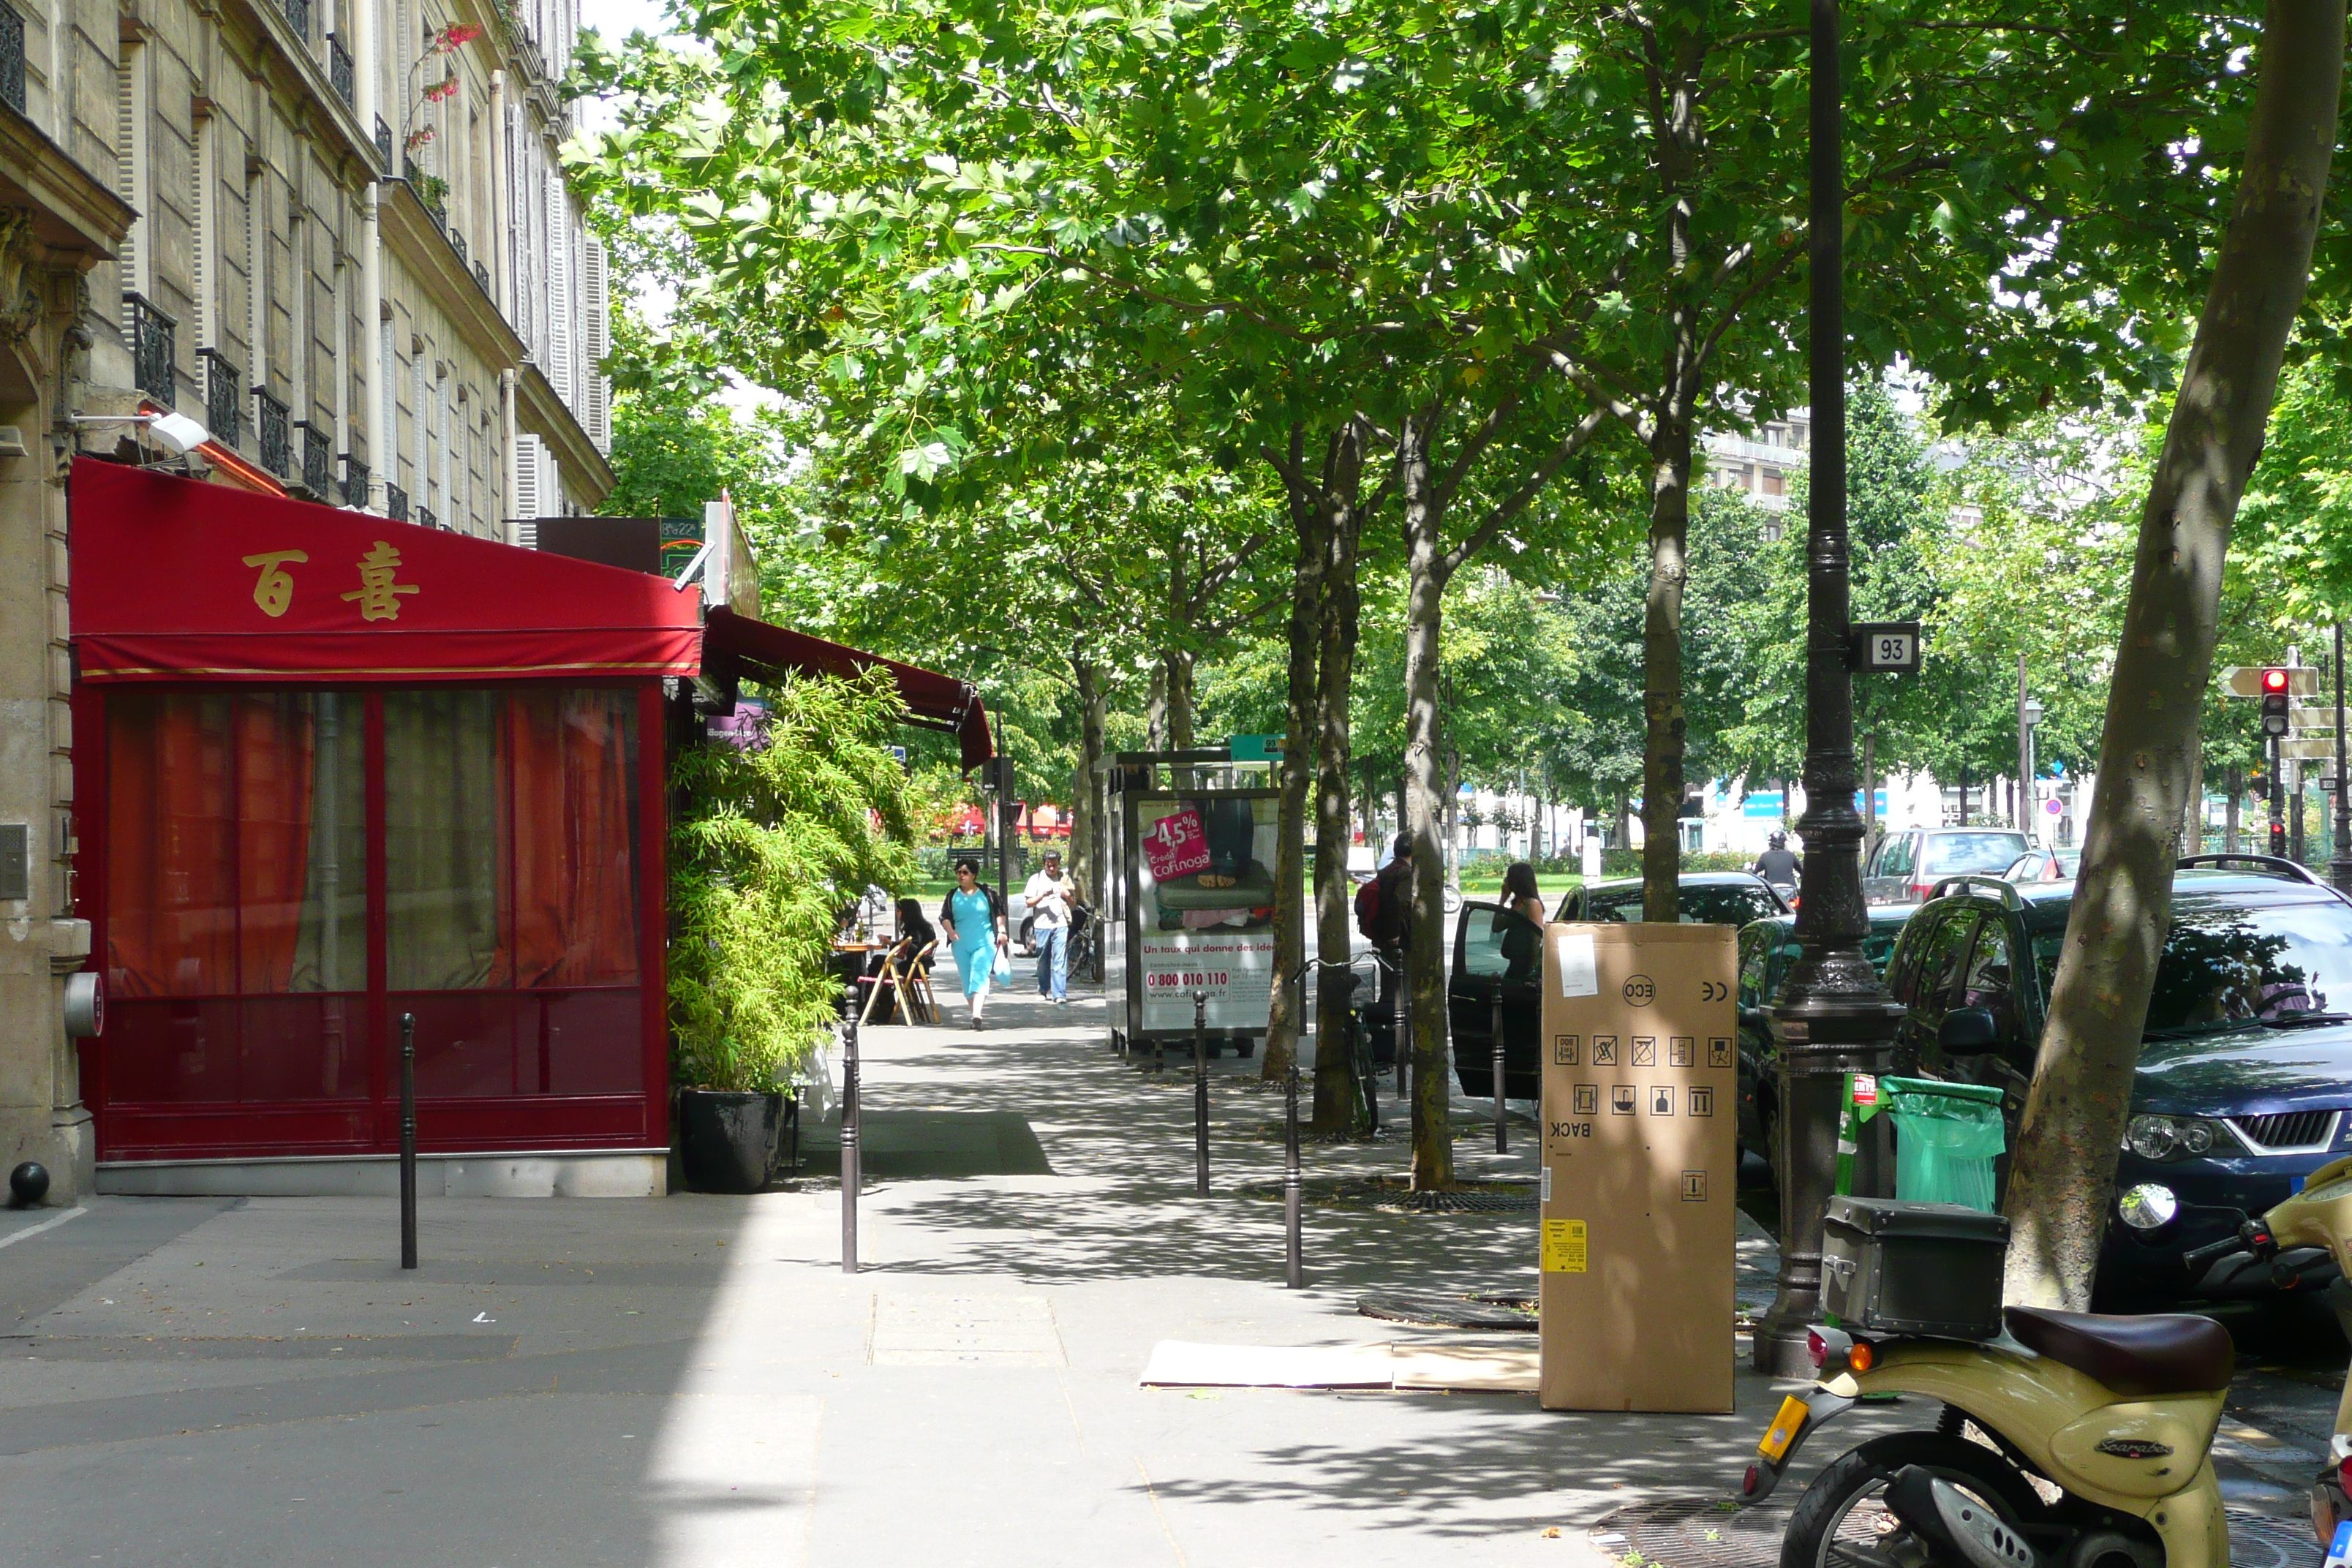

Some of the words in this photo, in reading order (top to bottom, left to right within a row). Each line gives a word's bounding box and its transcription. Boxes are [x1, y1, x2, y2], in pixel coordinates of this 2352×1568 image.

[1881, 639, 1903, 660] 93
[1265, 739, 1276, 747] 93
[1150, 852, 1175, 864] Crédit
[1153, 853, 1210, 877] Cofinoga
[1144, 946, 1158, 954] Un
[1185, 944, 1200, 954] qui
[1203, 944, 1234, 953] donne
[1237, 943, 1254, 951] des
[1147, 973, 1156, 987] 0
[1158, 973, 1180, 986] 800
[1183, 973, 1204, 985] 010
[1207, 972, 1228, 985] 110
[1625, 984, 1653, 998] ECO
[1550, 1122, 1590, 1137] BACK
